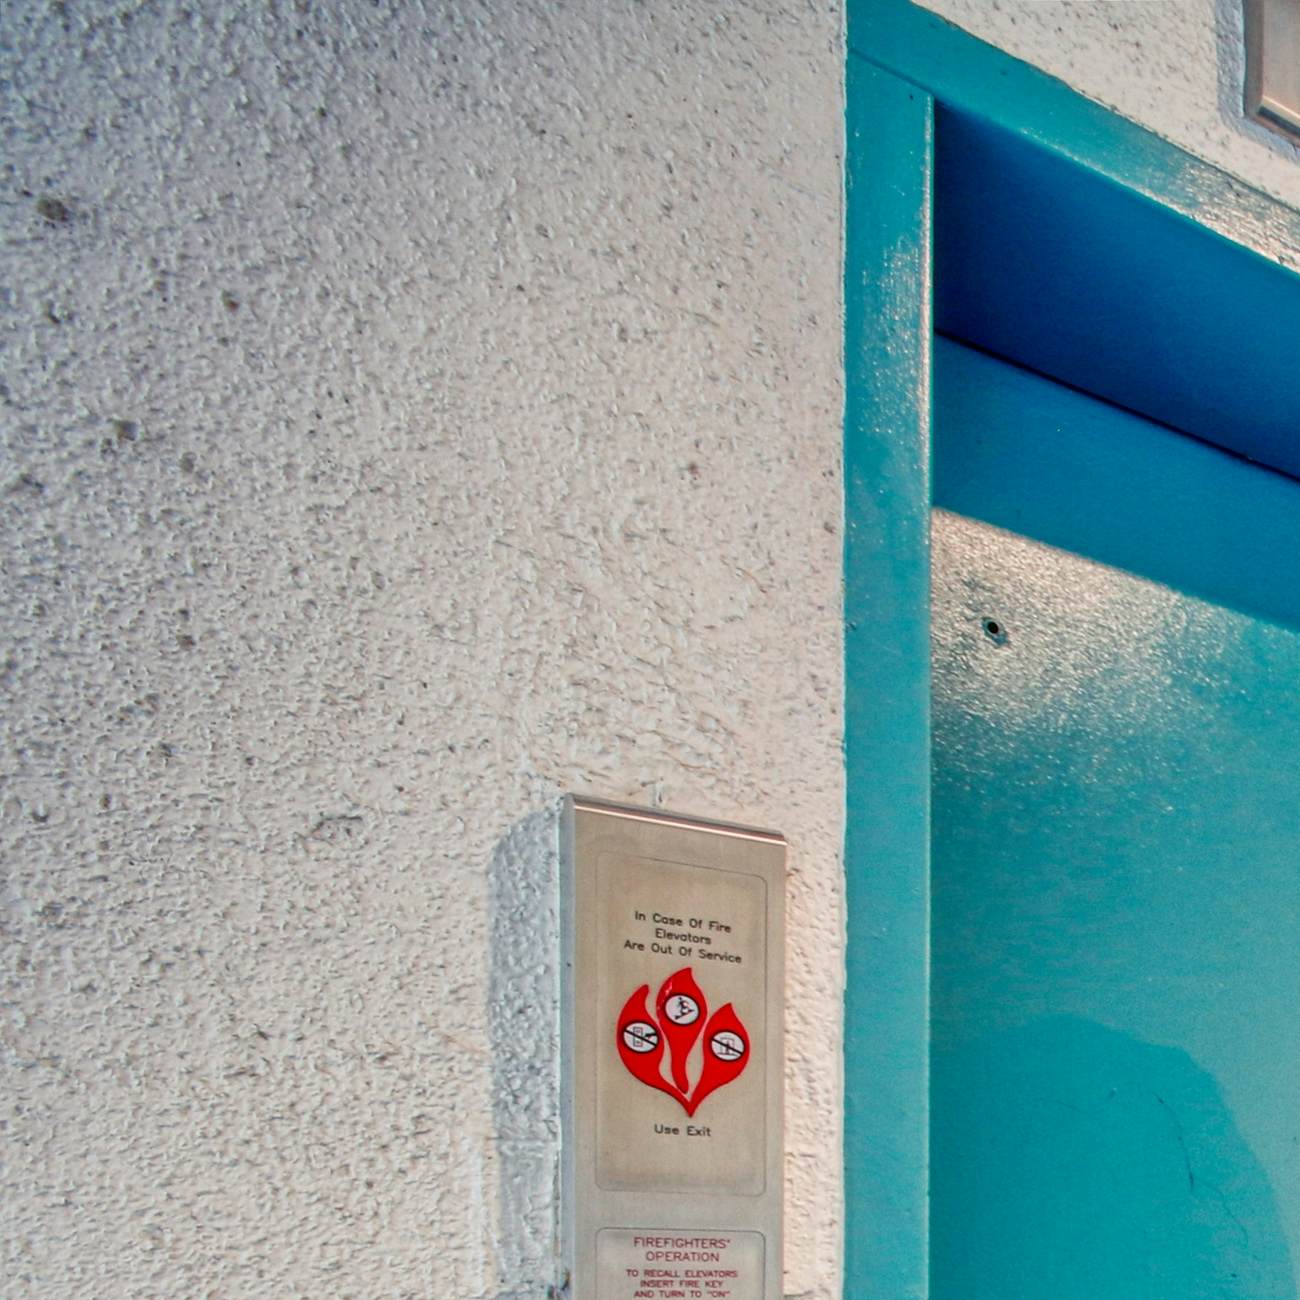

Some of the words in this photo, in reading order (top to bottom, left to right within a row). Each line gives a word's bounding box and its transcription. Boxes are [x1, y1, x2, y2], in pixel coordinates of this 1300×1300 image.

[634, 910, 646, 921] In
[652, 912, 683, 926] Case
[688, 918, 702, 929] Of
[708, 920, 732, 933] Fire
[655, 927, 712, 945] Elevators
[623, 939, 645, 951] Are
[650, 942, 673, 955] Out
[678, 946, 692, 957] Of
[698, 948, 742, 964] Service
[654, 1123, 680, 1135] Use
[686, 1125, 712, 1137] Exit
[645, 1250, 720, 1262] OPERATION
[626, 1268, 639, 1278] TO
[643, 1269, 681, 1278] RECALL
[684, 1269, 739, 1278] ELEVATORS
[640, 1279, 674, 1288] INSERT
[679, 1280, 700, 1288] FIRE
[704, 1280, 724, 1289] KEY
[633, 1290, 655, 1299] AND
[659, 1290, 686, 1299] TURN
[690, 1290, 703, 1299] TO
